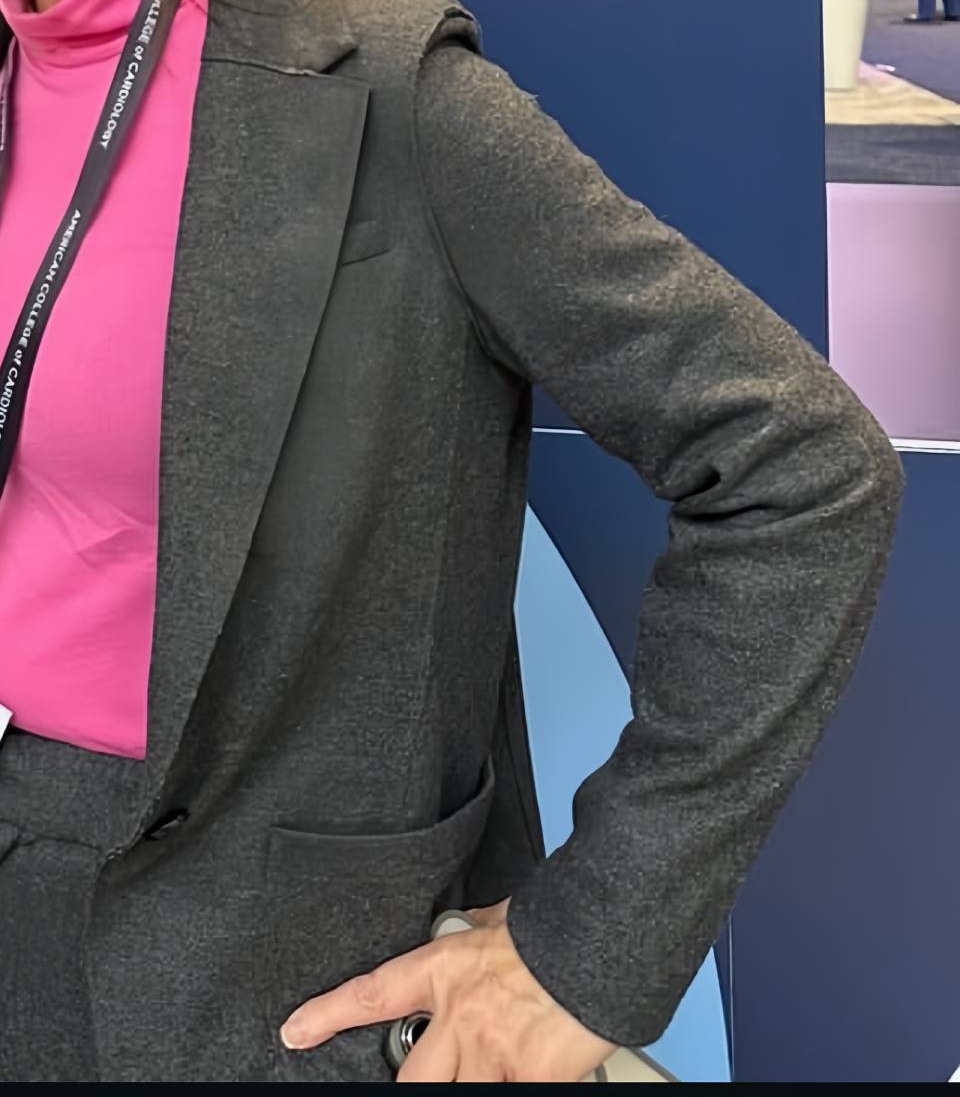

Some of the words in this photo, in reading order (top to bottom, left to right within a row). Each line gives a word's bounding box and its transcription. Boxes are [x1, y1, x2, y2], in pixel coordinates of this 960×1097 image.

[133, 45, 145, 61] of
[99, 61, 139, 150] CARDIOLOGY
[45, 209, 81, 282] AMERICAN
[19, 282, 50, 348] COLLEGE
[13, 349, 23, 366] of
